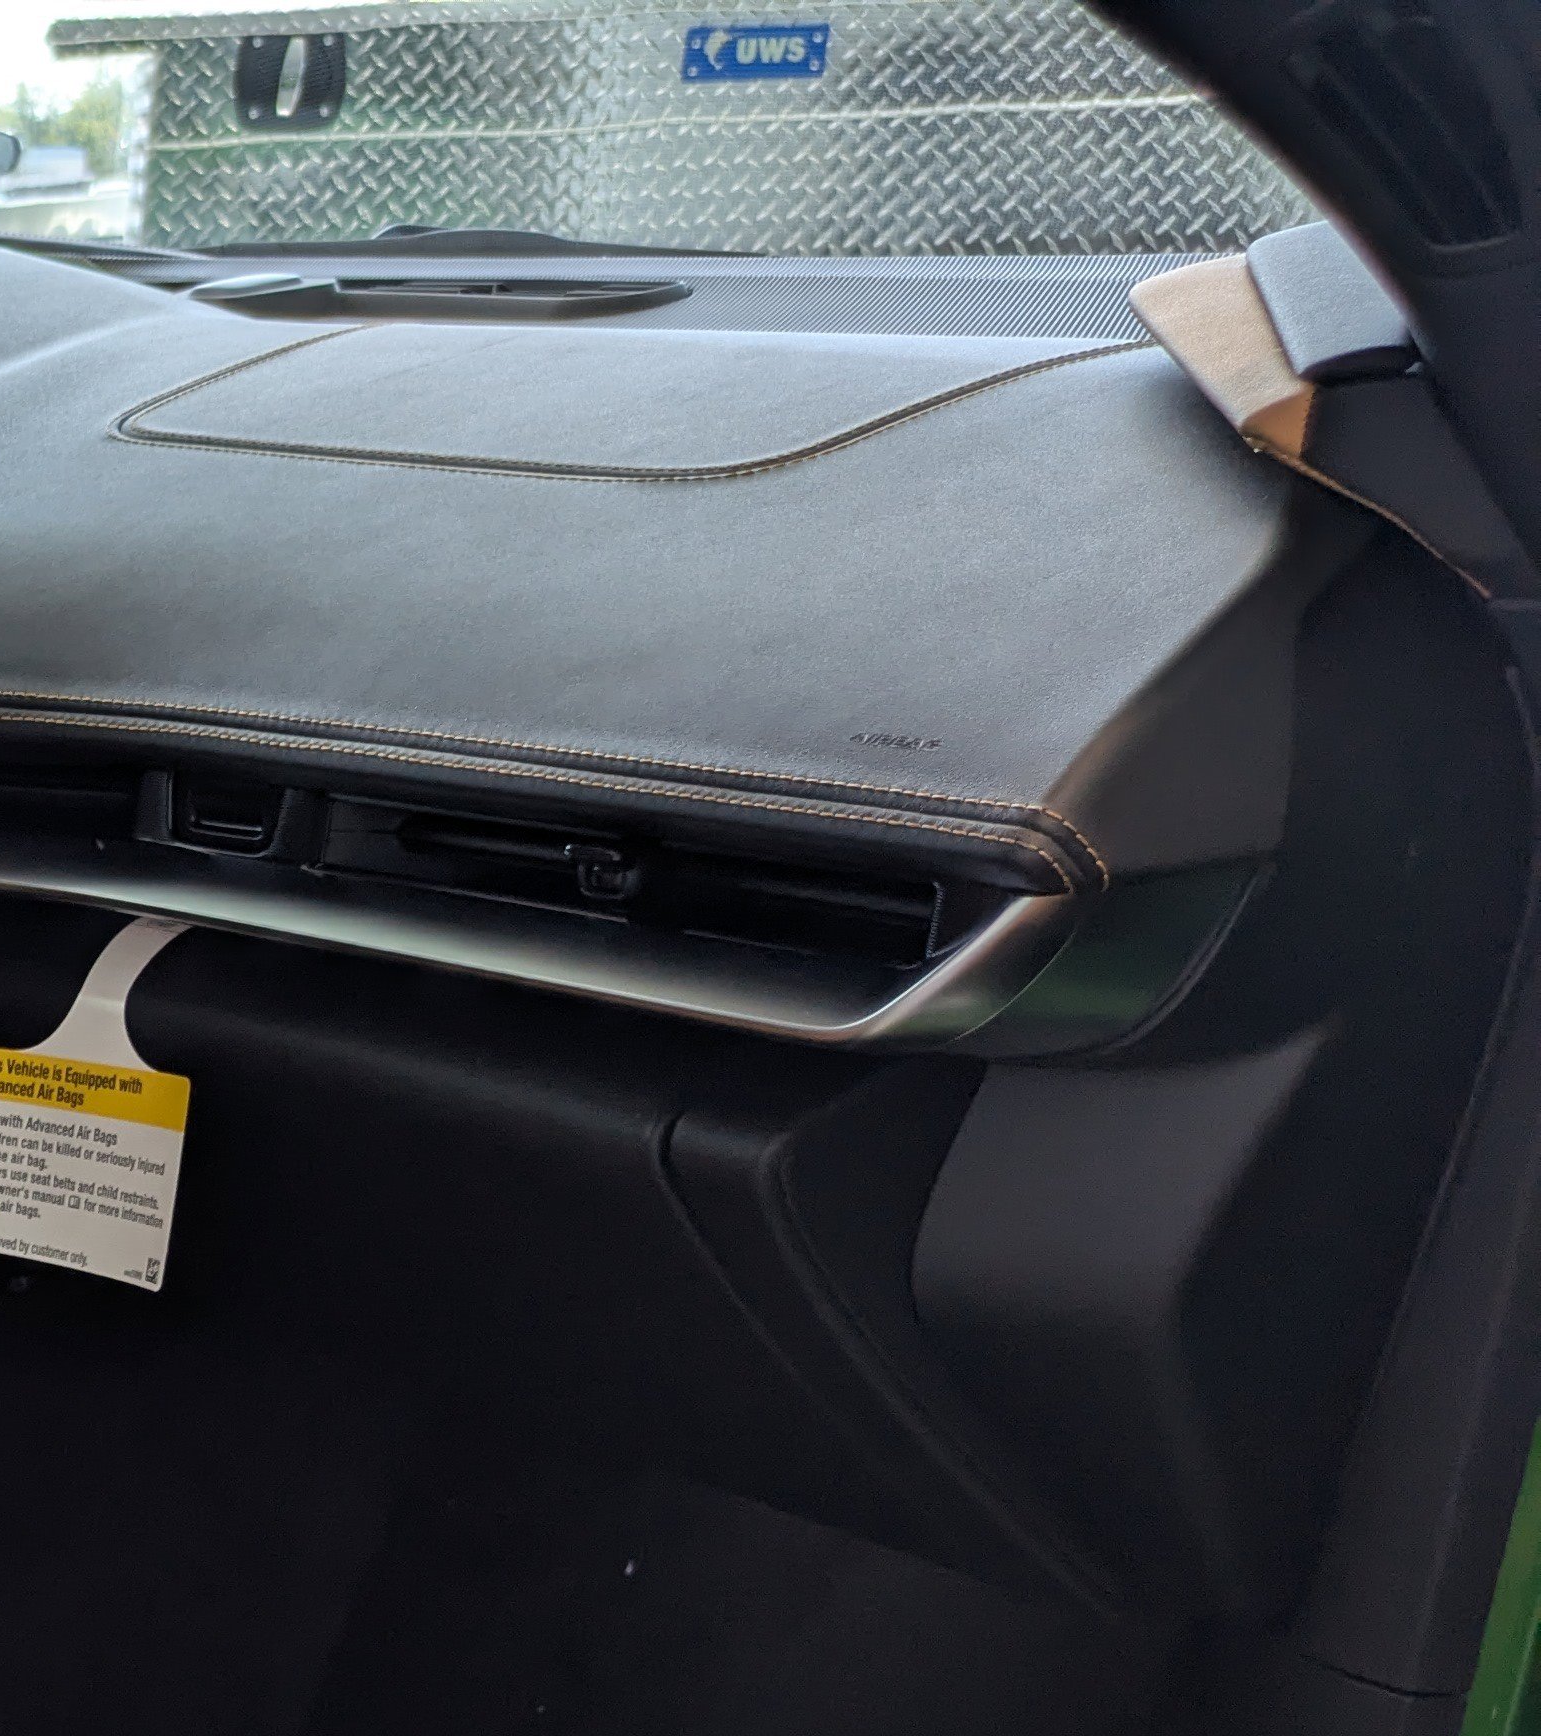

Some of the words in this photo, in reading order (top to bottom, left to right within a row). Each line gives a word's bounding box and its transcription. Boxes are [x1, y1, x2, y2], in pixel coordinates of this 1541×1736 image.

[735, 37, 805, 65] UWS
[7, 1058, 49, 1079] Vehicle
[52, 1065, 62, 1081] is
[64, 1066, 117, 1091] Equipped
[119, 1076, 143, 1094] with
[37, 1083, 55, 1101] Air
[56, 1086, 85, 1108] Bags
[0, 1114, 24, 1129] with
[25, 1117, 76, 1138] Advanced
[77, 1124, 92, 1141] Air
[93, 1128, 118, 1147] Bags
[10, 1152, 25, 1165] air
[27, 1153, 48, 1172] bag.
[20, 1138, 40, 1149] can
[41, 1139, 54, 1153] be
[55, 1141, 82, 1159] killed
[83, 1149, 95, 1160] or
[96, 1151, 137, 1172] seriously
[137, 1157, 166, 1176] injured
[10, 1170, 28, 1183] use
[30, 1173, 51, 1186] seat
[52, 1174, 76, 1192] belts
[77, 1182, 96, 1195] and
[97, 1184, 119, 1200] child
[0, 1200, 14, 1213] air
[15, 1202, 41, 1220] bags.
[31, 1190, 65, 1206] manual
[83, 1198, 97, 1213] for
[97, 1203, 120, 1218] more
